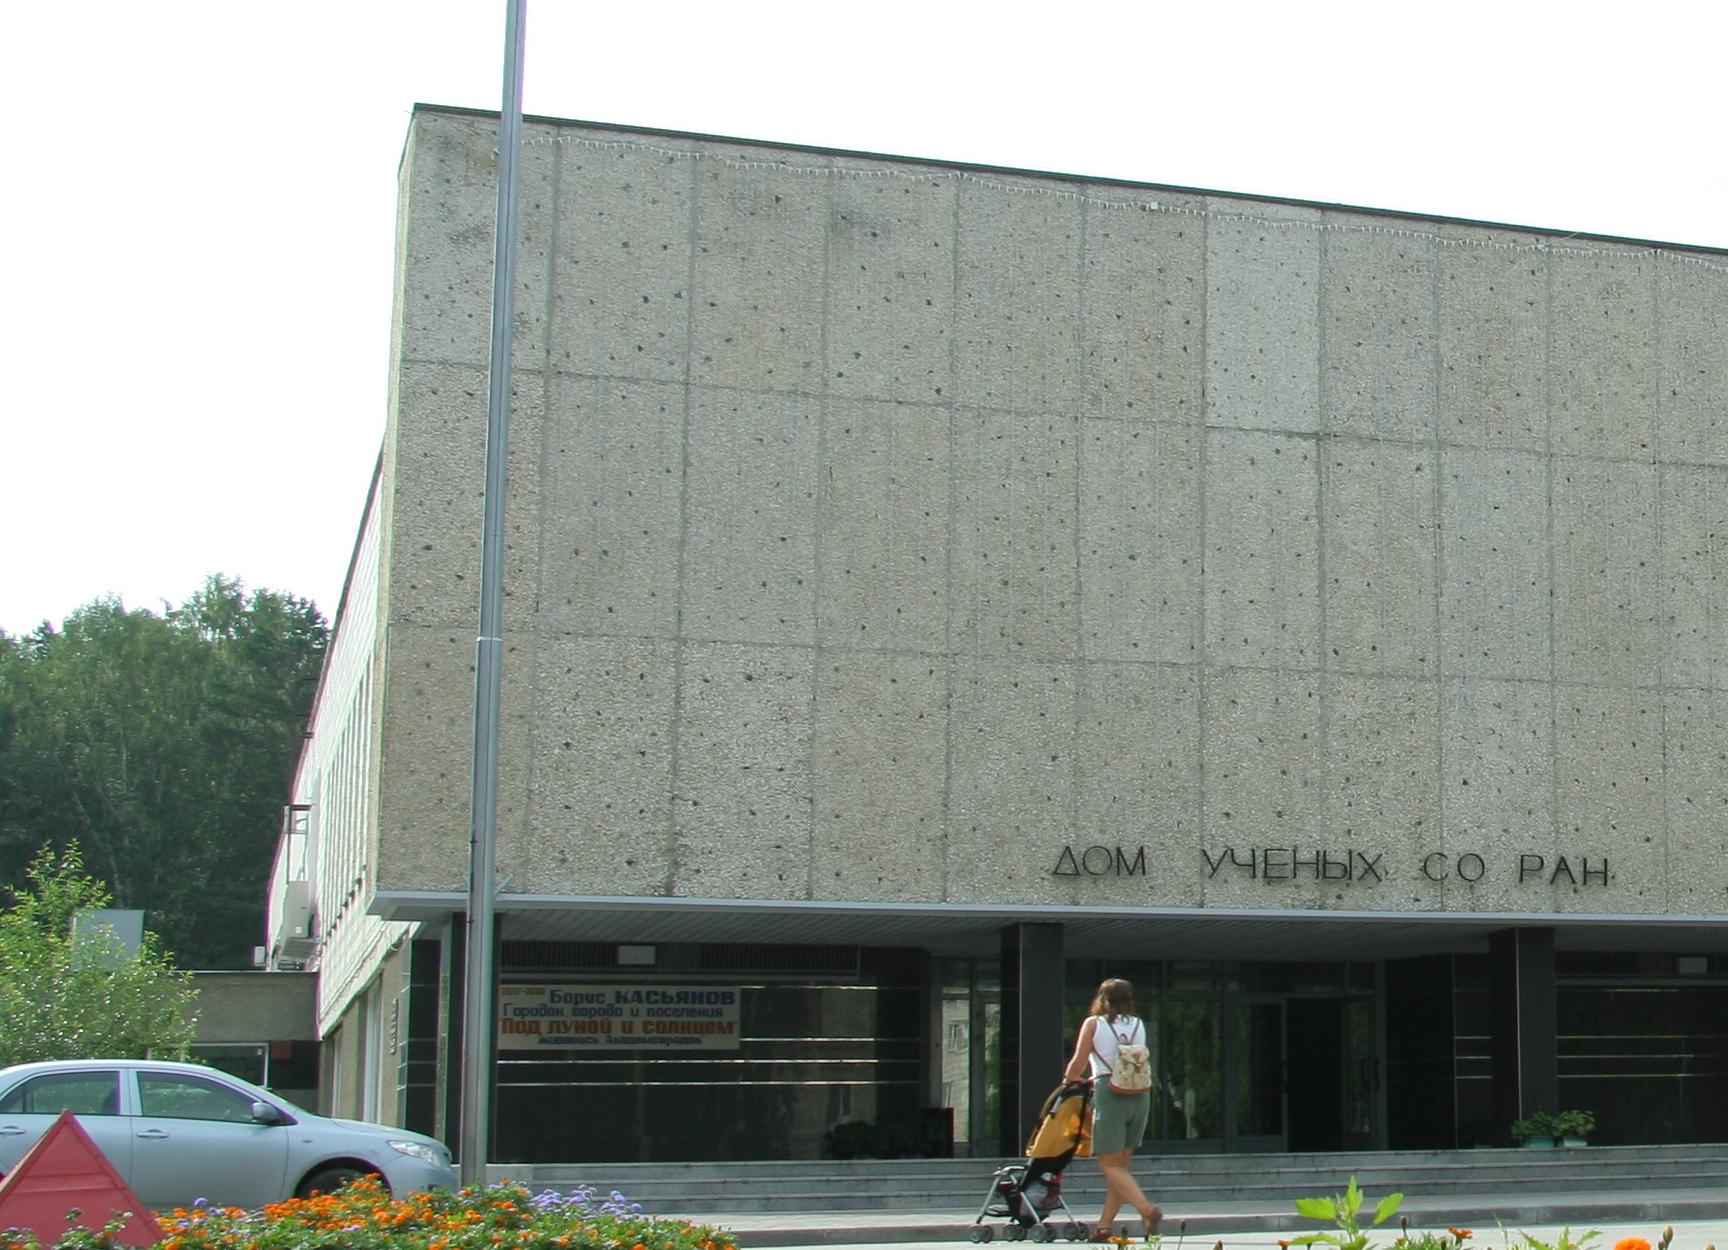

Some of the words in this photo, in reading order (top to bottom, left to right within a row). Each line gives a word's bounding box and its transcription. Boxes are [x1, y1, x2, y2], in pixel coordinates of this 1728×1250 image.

[1052, 845, 1146, 876] ДОМ
[1202, 848, 1382, 882] УЧЕНЫХ
[1423, 852, 1485, 882] СО
[1519, 854, 1608, 886] РАН
[550, 990, 606, 1005] Борис
[615, 990, 736, 1005] КАСЬЯНОВ
[631, 1008, 639, 1017] и
[647, 1007, 723, 1018] поселения
[547, 1018, 612, 1034] луной
[621, 1020, 634, 1034] и
